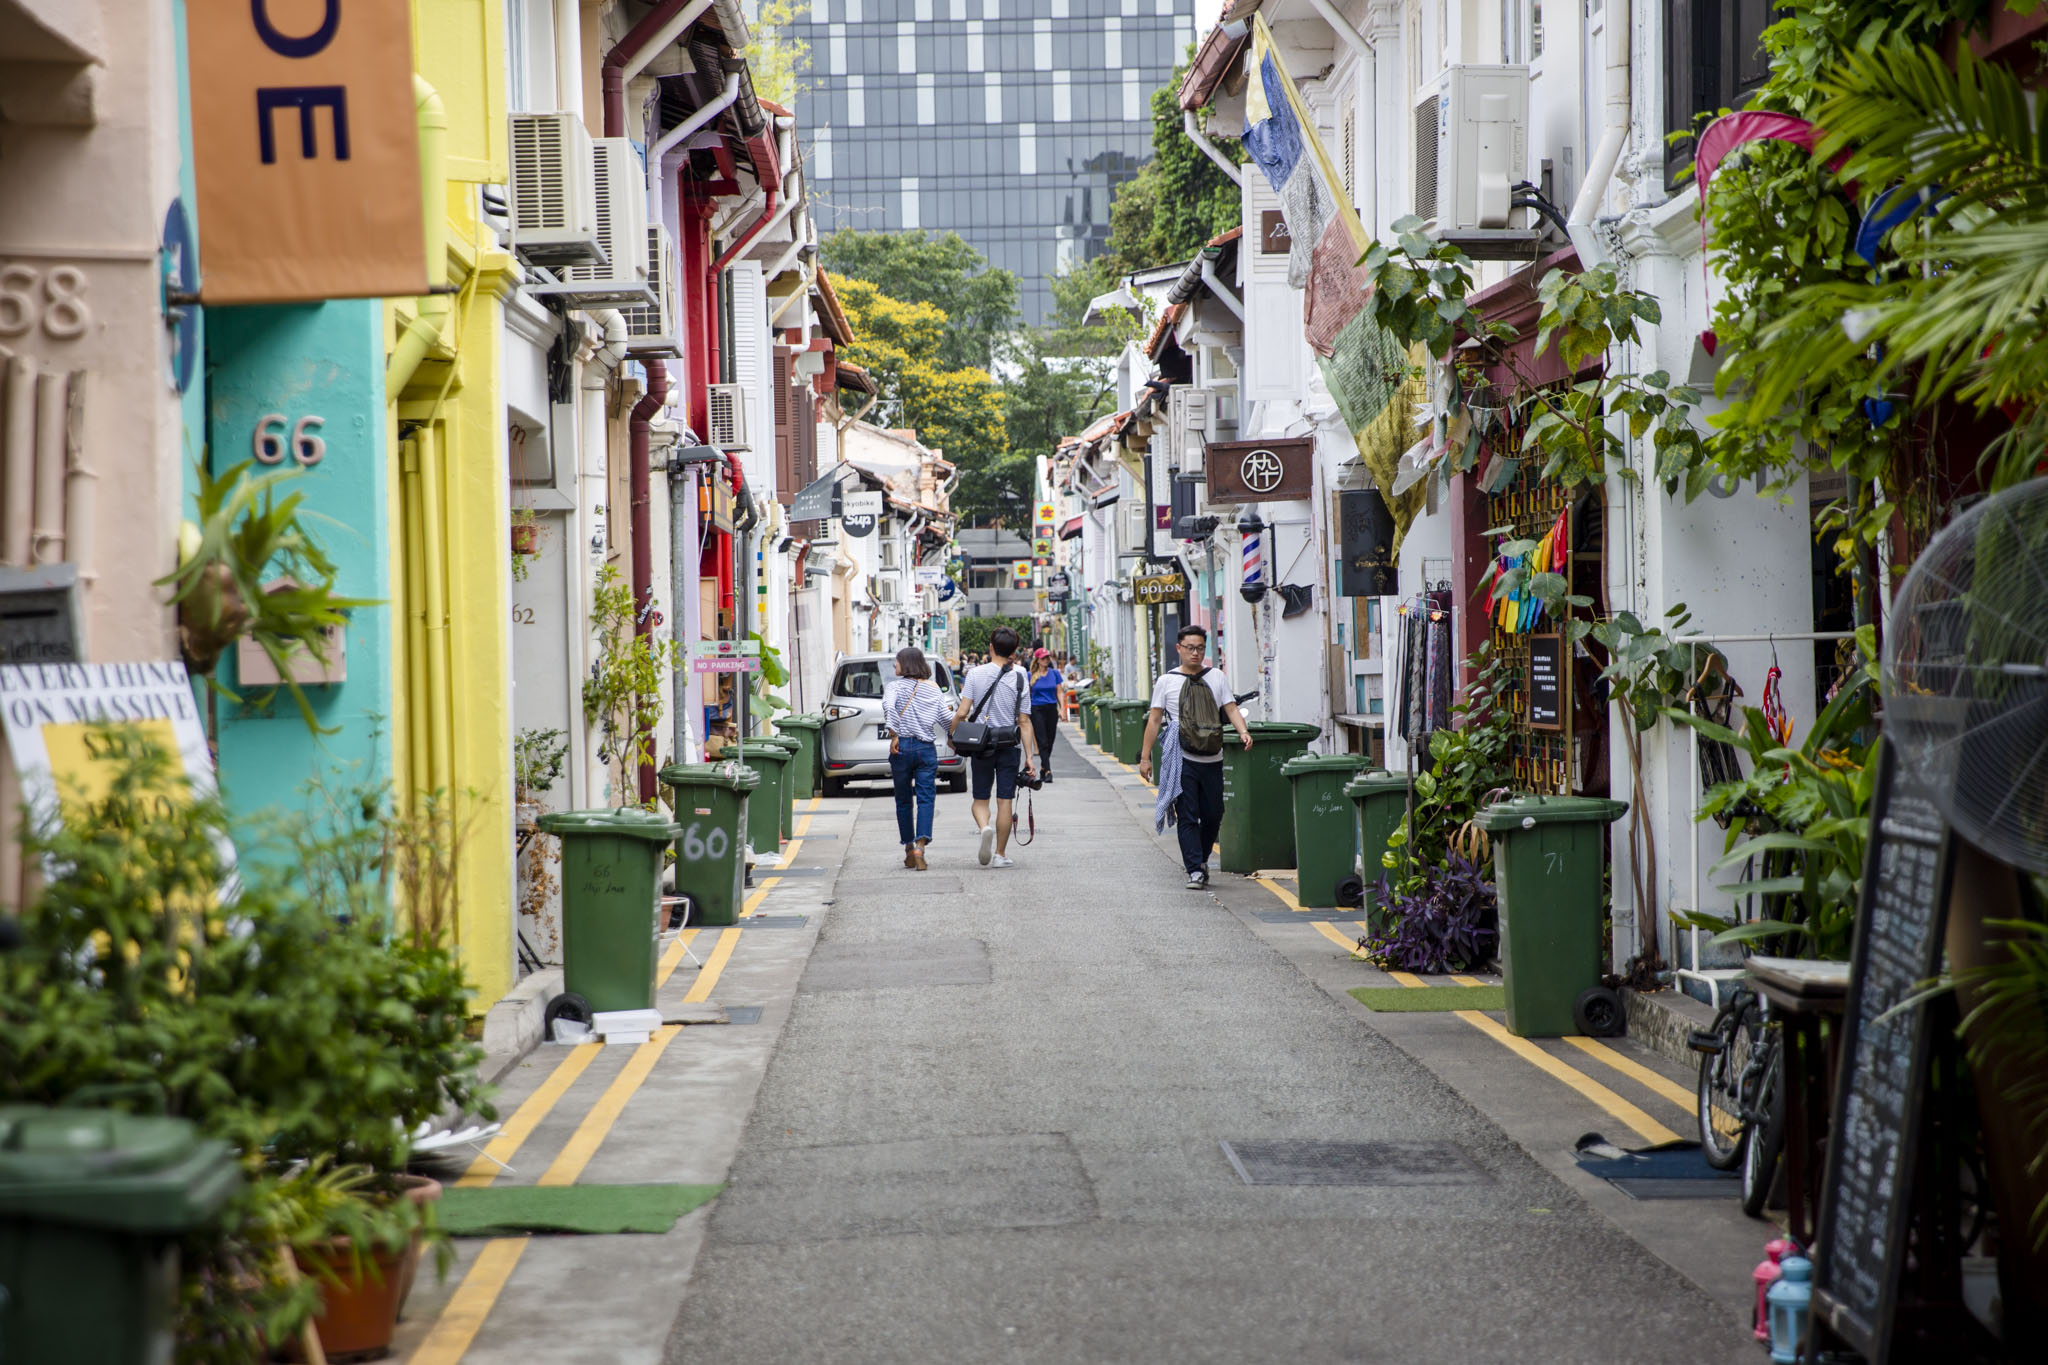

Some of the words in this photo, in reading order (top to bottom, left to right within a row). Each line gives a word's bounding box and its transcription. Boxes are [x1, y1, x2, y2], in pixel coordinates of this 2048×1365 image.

[253, 412, 326, 467] 66
[1245, 453, 1279, 488] 枠
[842, 500, 875, 508] okyobike
[511, 602, 535, 625] 62
[0, 663, 186, 692] EVERYTHING
[697, 661, 708, 669] NO
[711, 660, 745, 669] PARKING
[12, 698, 56, 728] ON
[65, 694, 193, 724] MASSIVE
[684, 822, 729, 861] 60
[1544, 852, 1563, 875] 71
